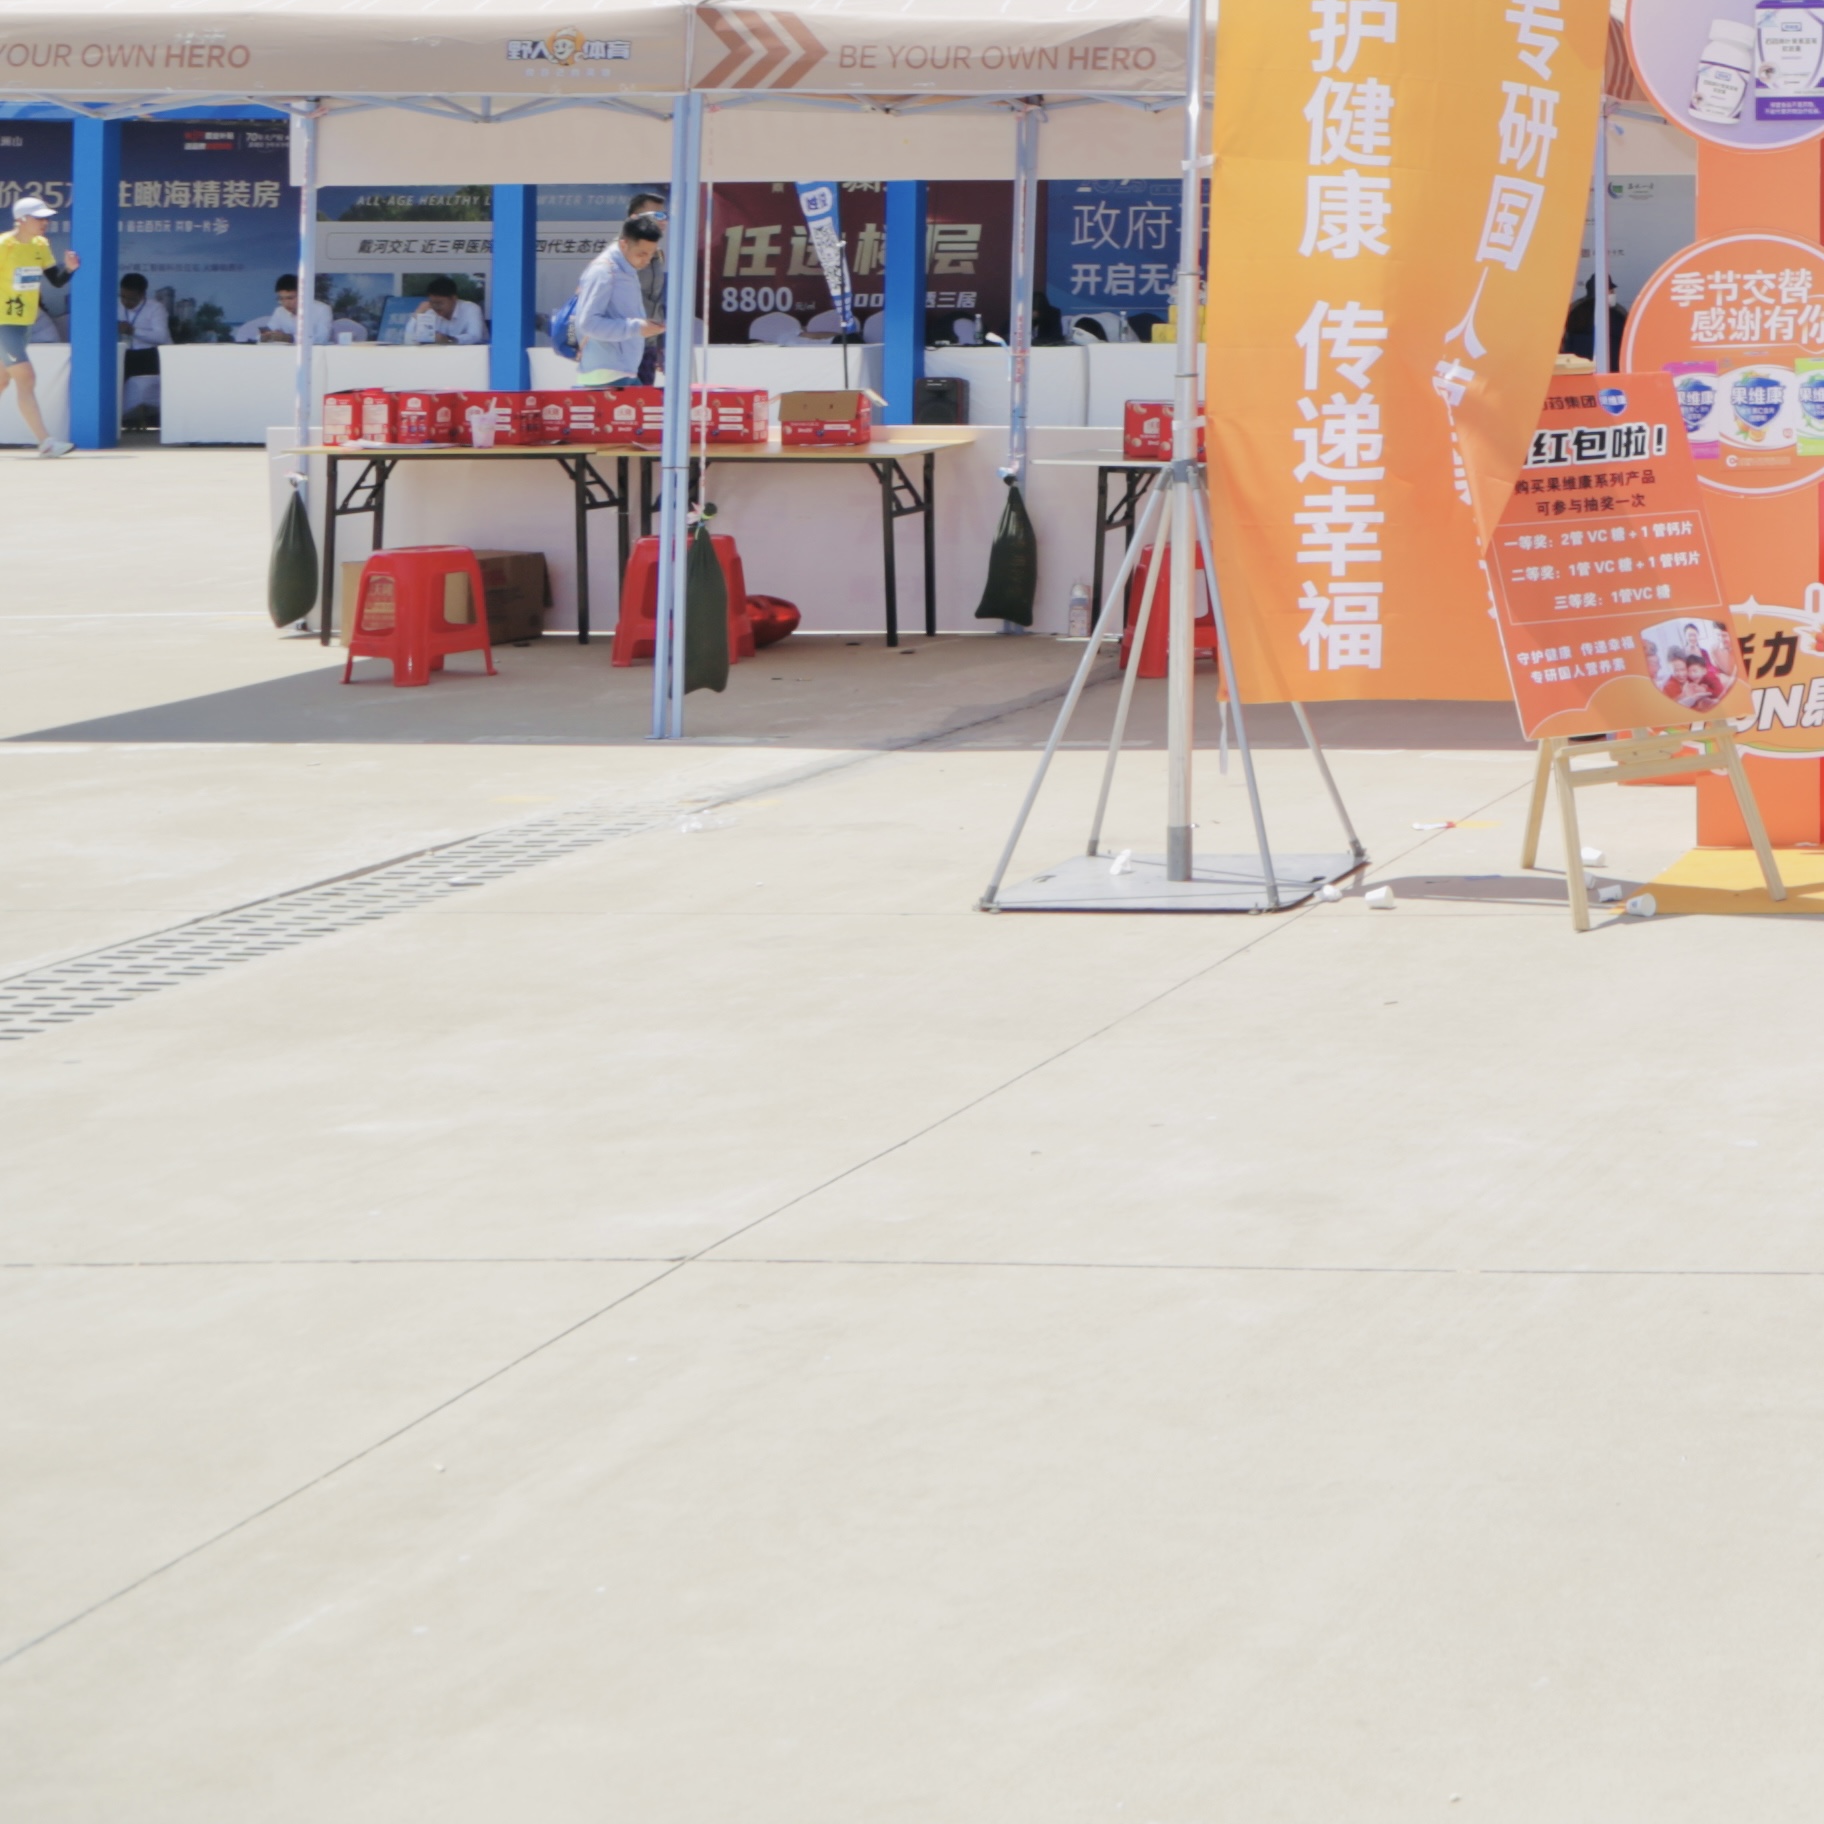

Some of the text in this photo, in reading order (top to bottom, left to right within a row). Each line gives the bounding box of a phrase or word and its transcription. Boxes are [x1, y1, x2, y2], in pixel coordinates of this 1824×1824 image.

[81, 44, 158, 68] OWN
[164, 44, 251, 68] HERO
[839, 45, 1157, 71] BE YOUR OWN HERO
[357, 195, 413, 206] ALL-AGE
[419, 195, 482, 206] HEALTHY
[721, 286, 793, 313] 8800
[1671, 268, 1812, 307] 季节交替
[1542, 394, 1597, 412] 药集团
[1731, 386, 1785, 406] 果维康
[1524, 426, 1667, 467] 红包啦!
[1293, 300, 1389, 671] 传递幸福
[1514, 469, 1656, 495] 购买果维康系列产品
[1536, 494, 1646, 516] 可参与抽奖一次
[1587, 528, 1607, 543] VC
[1594, 560, 1615, 575] VC
[1516, 636, 1636, 667] 守护健康 传递幸福
[1530, 658, 1626, 685] 专研国人营养素
